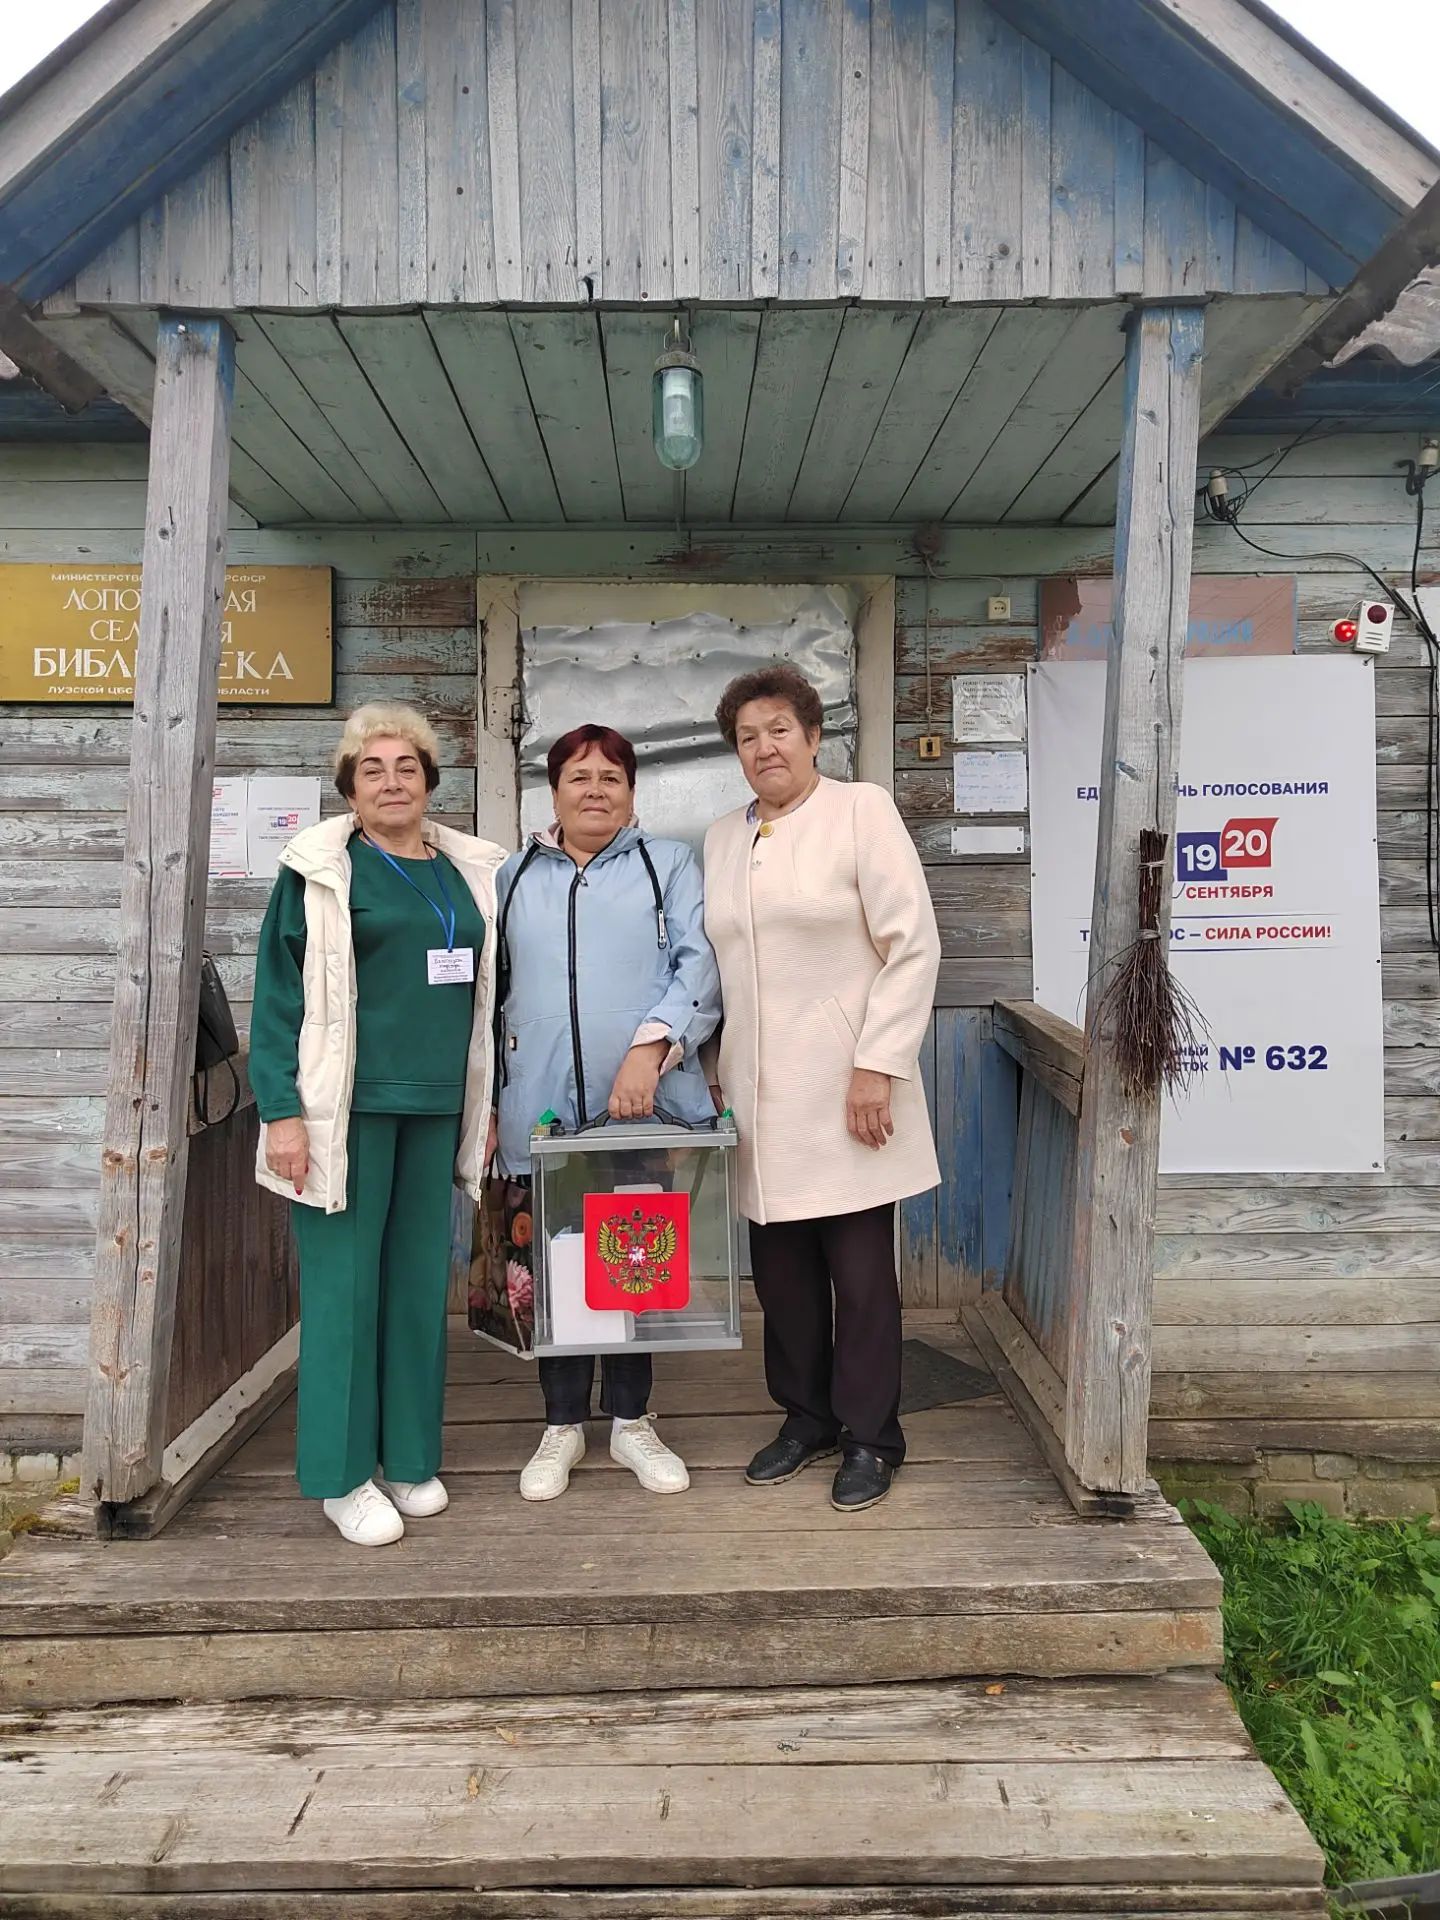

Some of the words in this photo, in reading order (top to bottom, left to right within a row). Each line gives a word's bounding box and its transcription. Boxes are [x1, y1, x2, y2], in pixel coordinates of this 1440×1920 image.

[62, 588, 256, 612] ЛОПОАЯ
[90, 619, 233, 643] СЕЛЯ
[33, 648, 294, 680] БИБЛЕКА
[48, 685, 104, 694] ЛУЗСКОЙ
[1202, 782, 1329, 796] ГОЛОСОВАНИЯ
[1182, 844, 1217, 871] 19
[1225, 829, 1268, 857] 20
[1186, 886, 1273, 899] СЕНТЯБРЯ
[1205, 927, 1251, 940] СИЛА
[1256, 926, 1331, 939] РОССИИ!
[1220, 1046, 1256, 1070] №
[1265, 1045, 1328, 1070] 632
